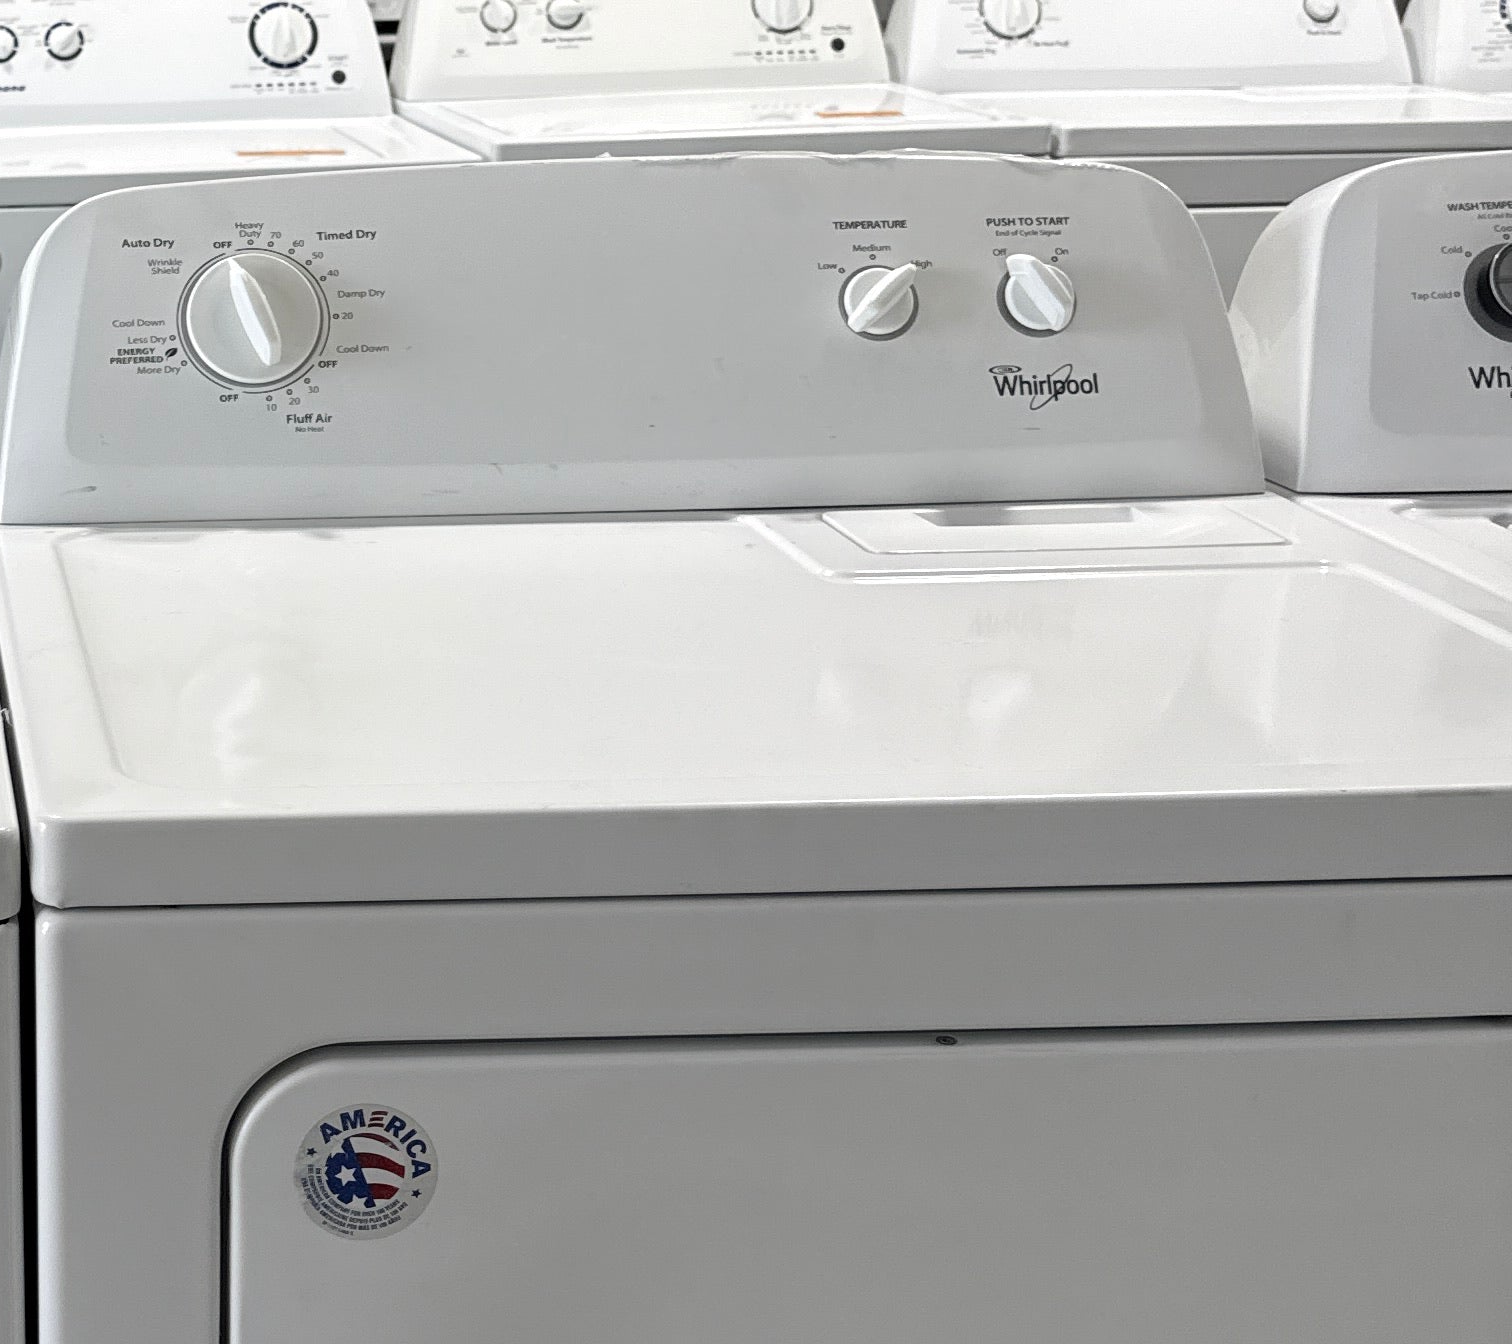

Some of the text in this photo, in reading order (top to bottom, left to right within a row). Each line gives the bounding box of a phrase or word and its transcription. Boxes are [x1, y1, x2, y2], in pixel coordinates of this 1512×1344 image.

[1447, 203, 1479, 211] WASH
[235, 222, 264, 231] Heavy
[832, 220, 908, 230] TEMPERATURE
[986, 217, 1070, 227] PUSH TO START
[239, 230, 262, 239] Duty
[270, 231, 282, 239] 70
[317, 230, 377, 241] Timed Dry
[121, 238, 175, 249] Auto Dry
[213, 241, 233, 249] OFF
[852, 244, 891, 252] Medium
[993, 248, 1007, 256] Off
[1441, 246, 1463, 255] Cold
[148, 259, 183, 267] Wrinkle
[817, 262, 838, 270] Low
[151, 267, 180, 275] Shield
[327, 269, 339, 277] 40
[338, 289, 385, 299] Damp Dry
[1411, 291, 1452, 302] Tap Cold
[341, 312, 354, 320] 20
[112, 319, 165, 328] Cool Down
[128, 336, 167, 345] Less Dry
[117, 348, 155, 356] ENERGY
[336, 344, 389, 354] Cool Down
[110, 356, 164, 364] PREFERRED
[318, 360, 338, 369] OFF
[137, 366, 181, 376] More Dry
[1468, 366, 1512, 389] Wh
[993, 368, 1099, 407] Whirlpool
[219, 394, 239, 403] OFF
[289, 397, 301, 405] 20
[286, 414, 333, 424] Fluff Air
[319, 1109, 432, 1179] AMERICA
